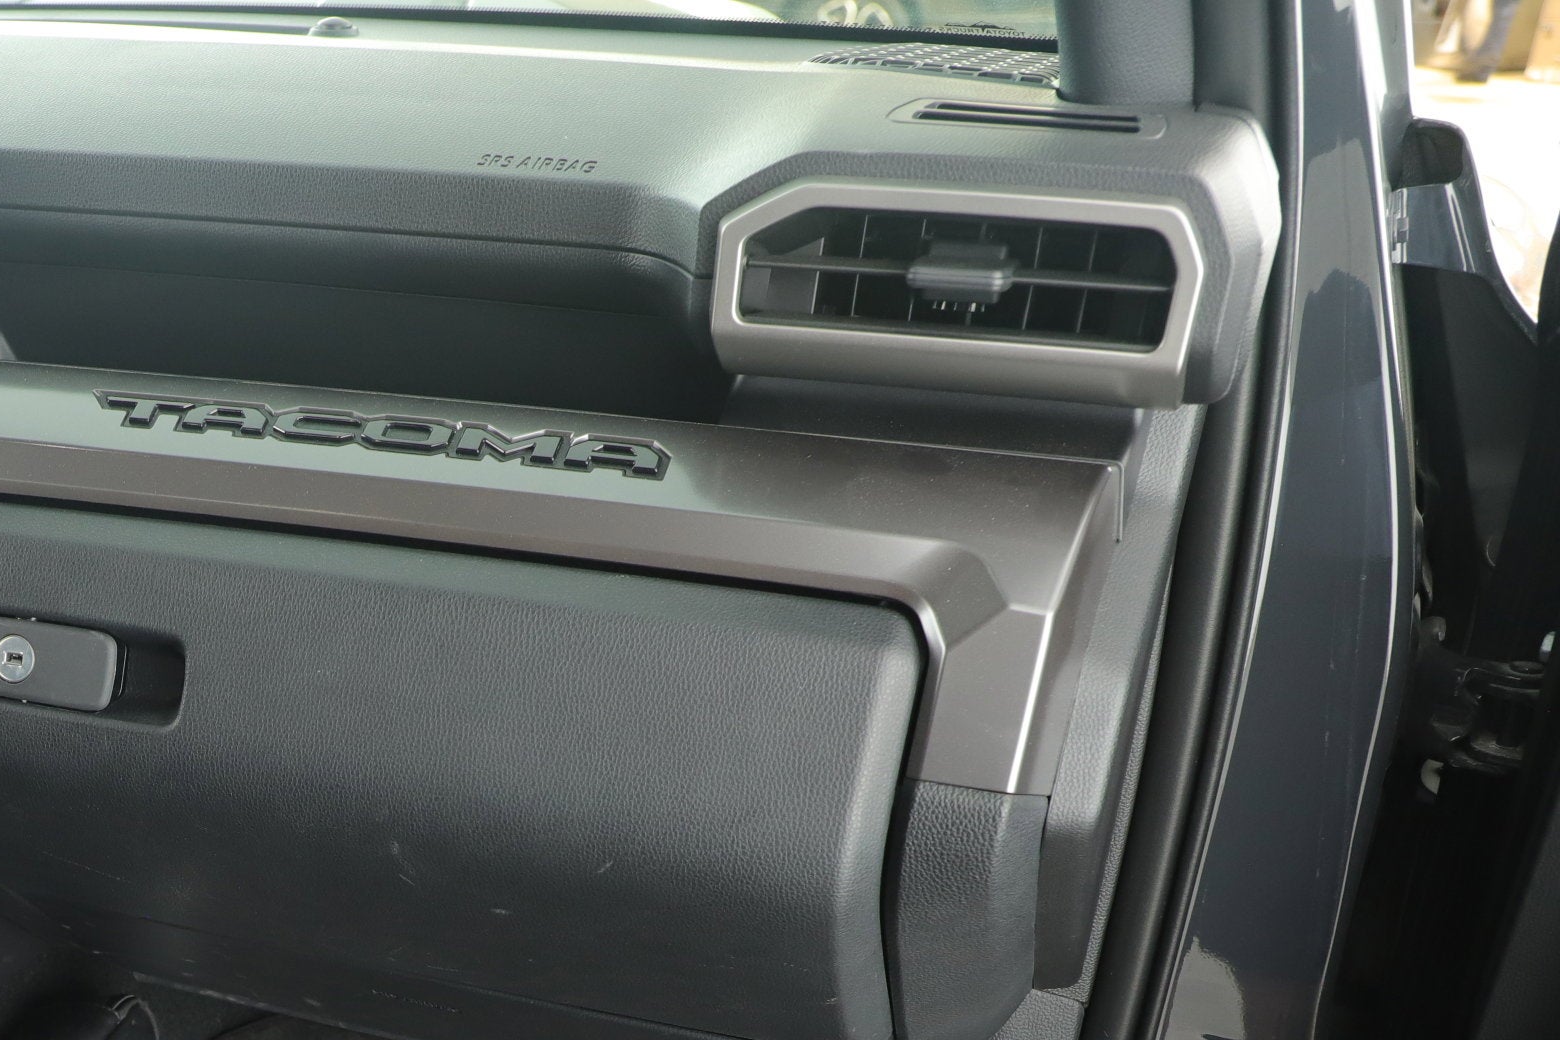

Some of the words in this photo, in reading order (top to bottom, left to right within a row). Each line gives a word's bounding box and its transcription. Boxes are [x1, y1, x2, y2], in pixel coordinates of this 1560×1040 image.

[476, 153, 514, 168] SRS
[515, 156, 598, 174] AIRBAG
[91, 388, 673, 481] TACOMA
